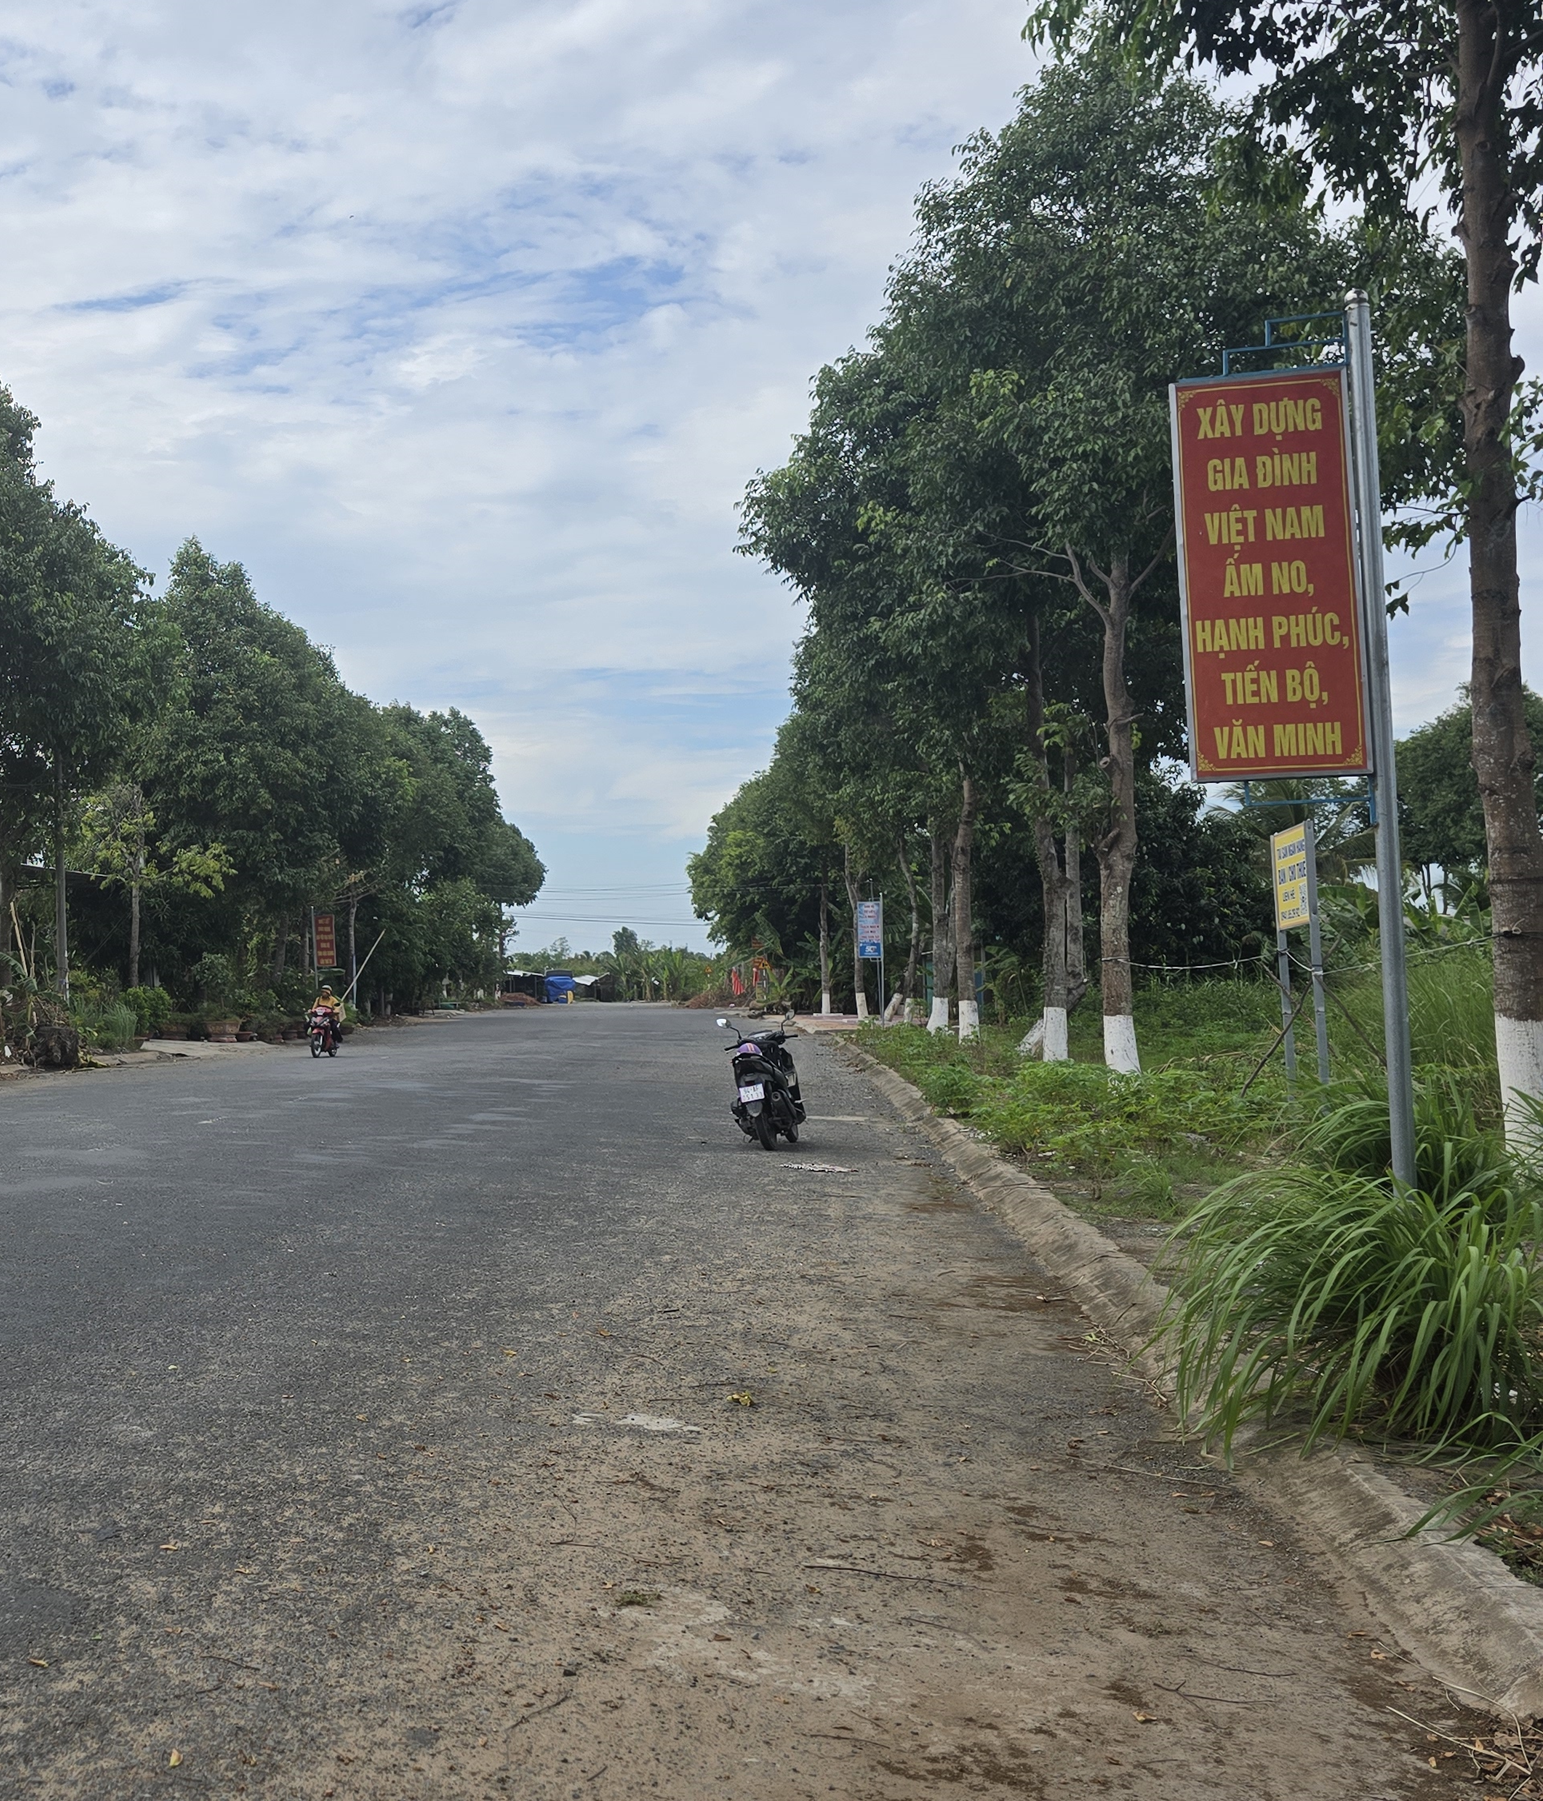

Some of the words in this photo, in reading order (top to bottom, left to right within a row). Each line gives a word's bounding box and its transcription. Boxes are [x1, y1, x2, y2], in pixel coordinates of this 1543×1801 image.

[1196, 398, 1244, 440] XÂY
[1253, 396, 1322, 441] DỰNG
[1207, 457, 1249, 492] GIA
[1256, 448, 1317, 488] ĐÌNH
[1204, 503, 1257, 551] VIỆT
[1264, 504, 1325, 540] NAM
[1223, 551, 1264, 598] ẤM
[1271, 560, 1314, 598] NO,
[1196, 617, 1264, 660] HẠNH
[1272, 606, 1349, 650] PHÚC,
[1221, 660, 1278, 705] TIẾN
[1286, 661, 1329, 709] BỘ,
[1213, 719, 1265, 760] VĂN
[1272, 721, 1342, 758] MINH
